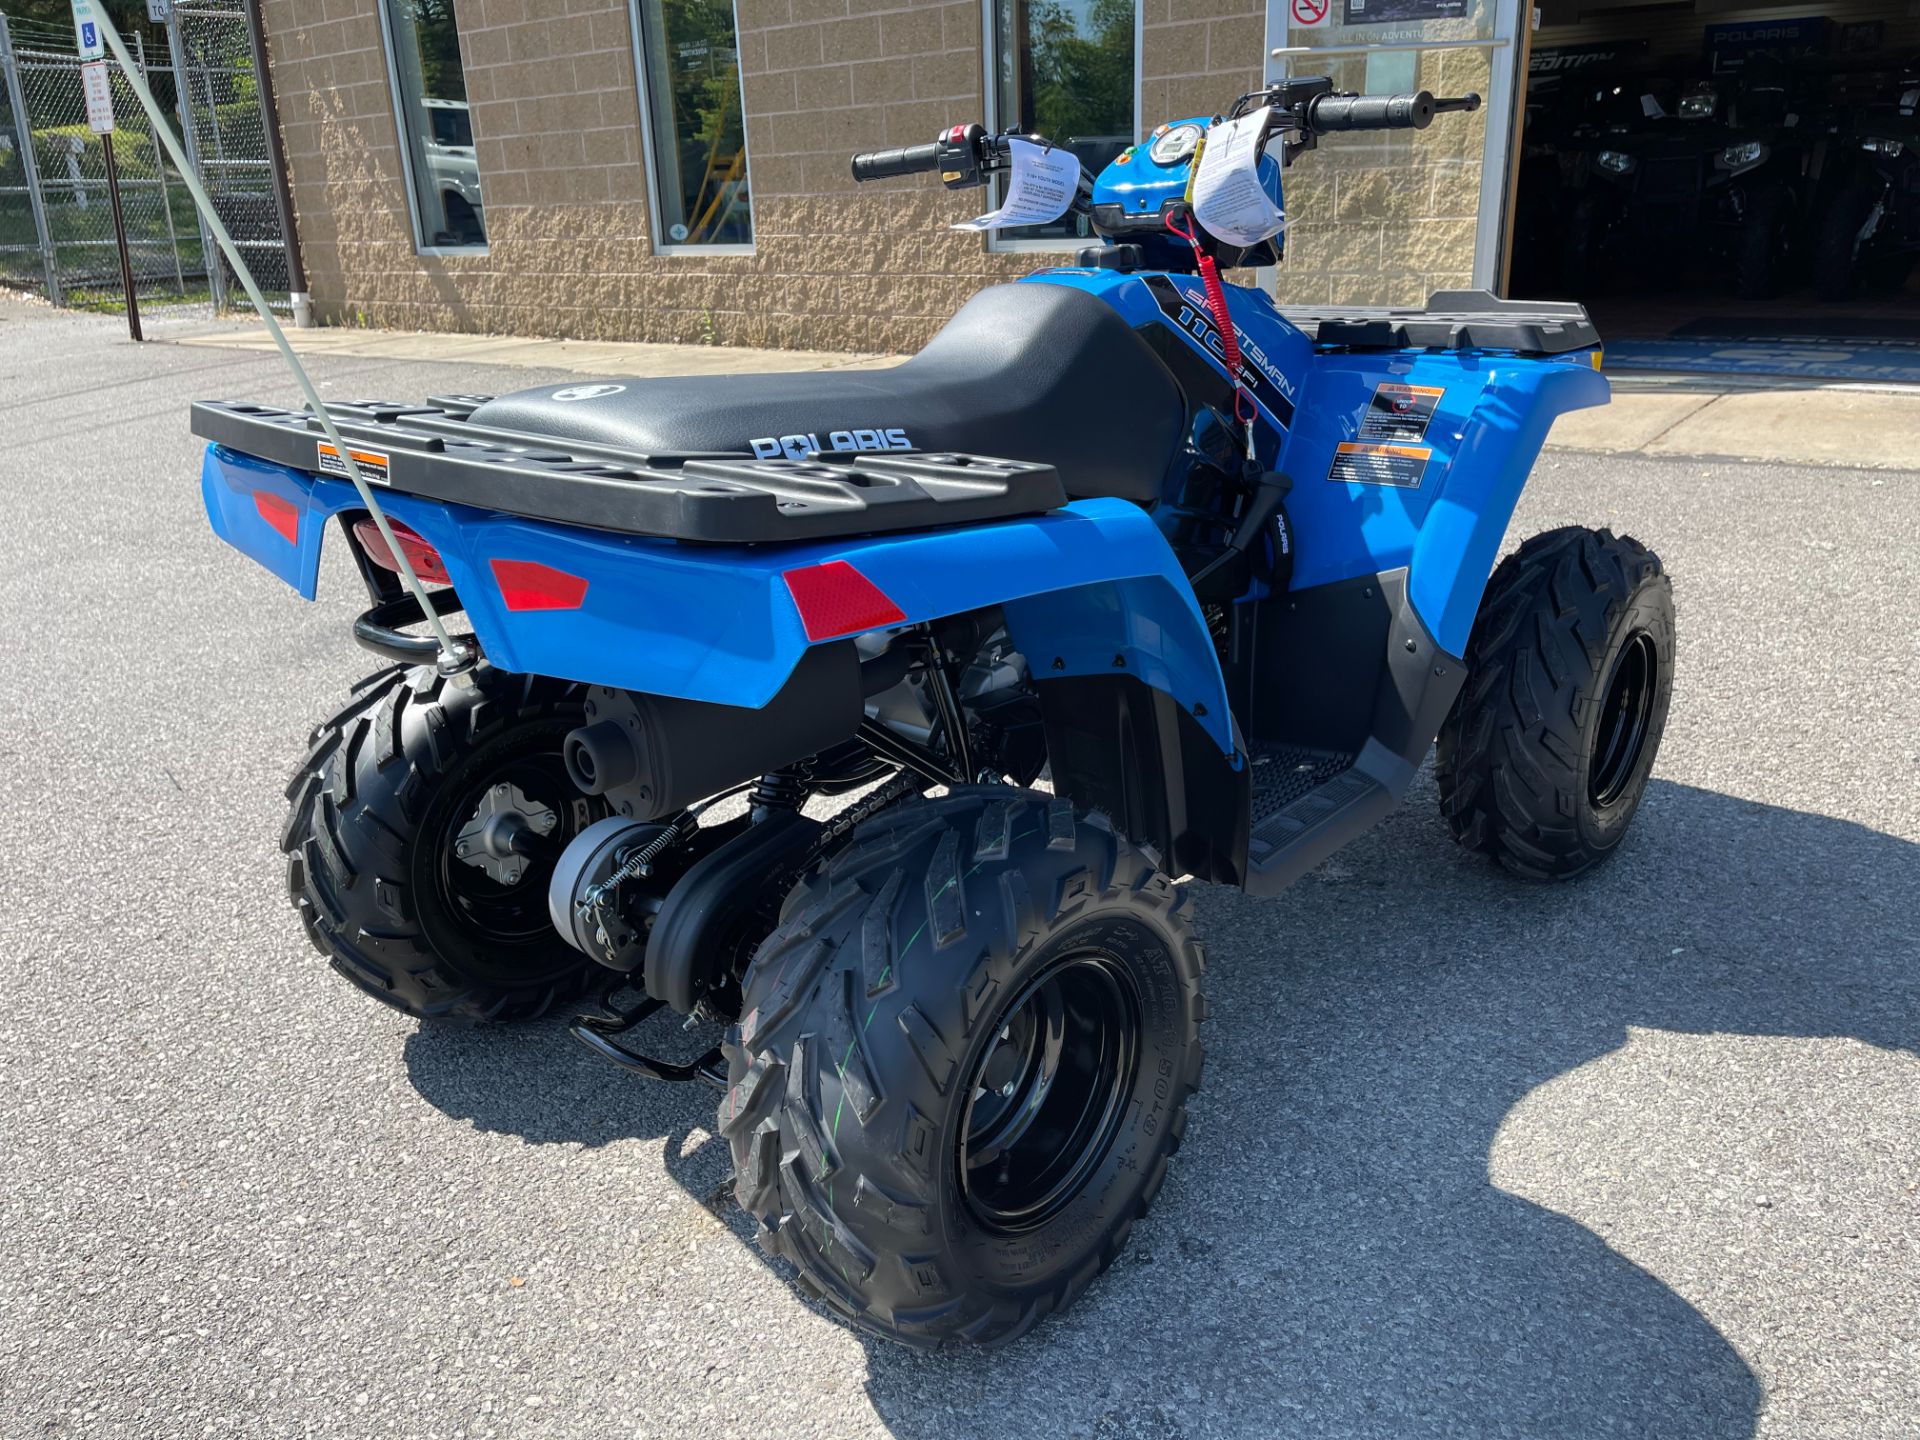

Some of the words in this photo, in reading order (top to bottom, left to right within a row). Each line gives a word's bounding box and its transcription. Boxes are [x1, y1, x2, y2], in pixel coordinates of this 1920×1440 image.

[1713, 27, 1801, 43] POLARIS
[749, 428, 913, 461] POLARIS
[1276, 513, 1289, 555] POLARIS
